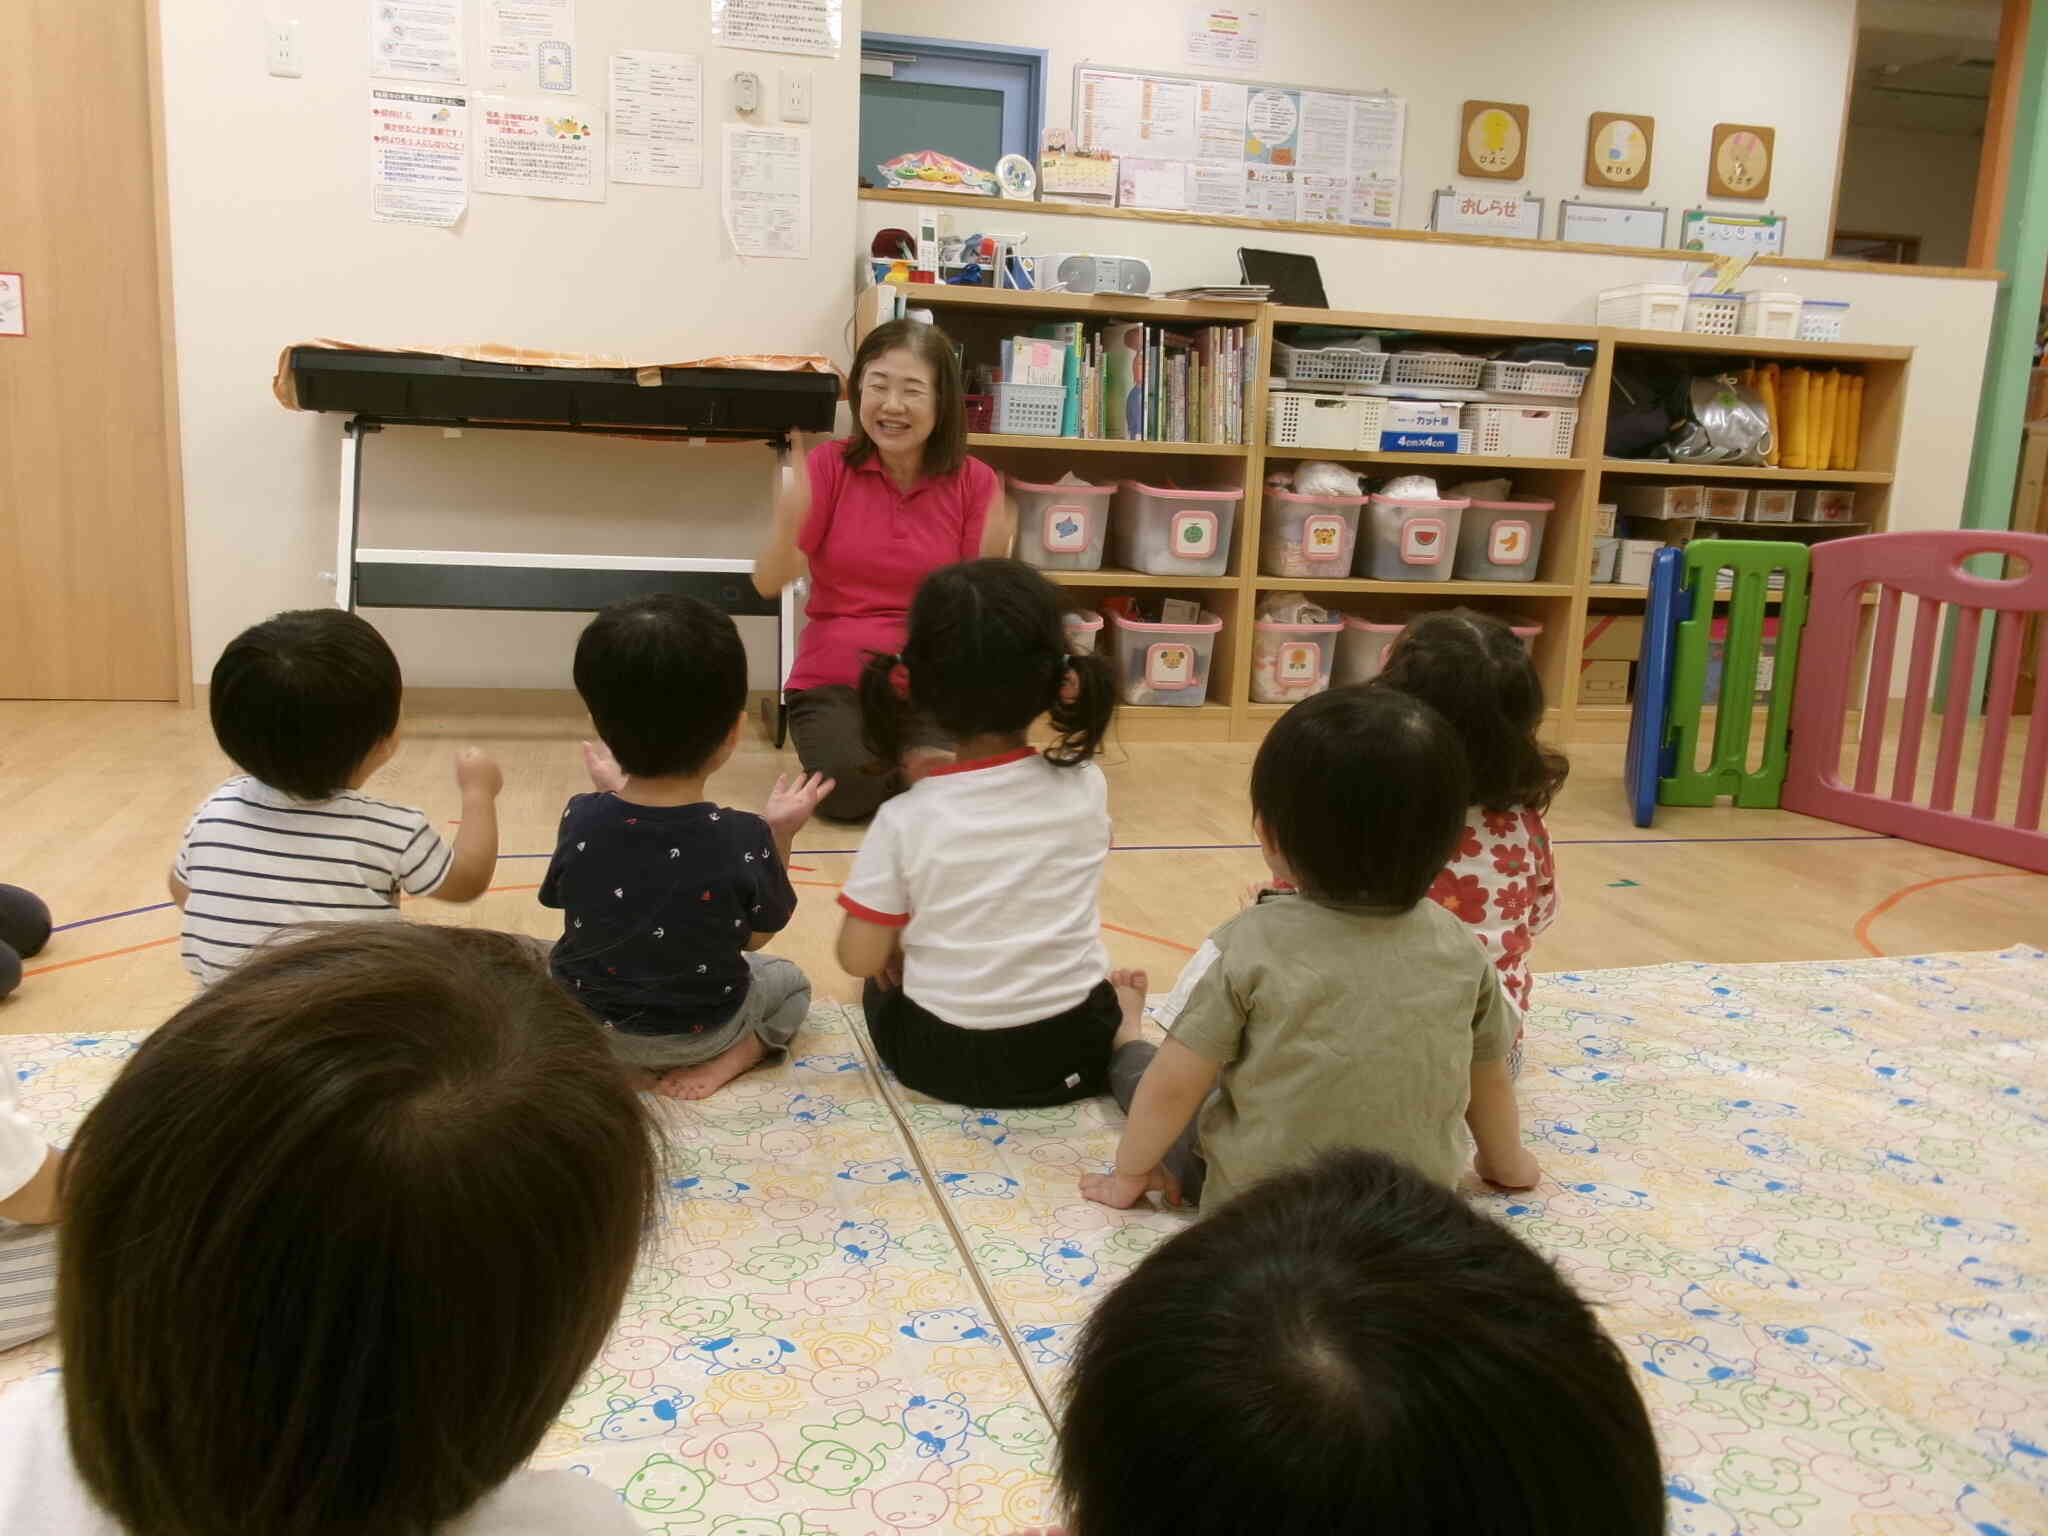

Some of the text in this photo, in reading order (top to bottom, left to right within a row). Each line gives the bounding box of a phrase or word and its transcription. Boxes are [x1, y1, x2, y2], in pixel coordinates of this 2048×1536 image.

[1479, 154, 1508, 166] ひよこ
[1461, 198, 1519, 218] おしらせ
